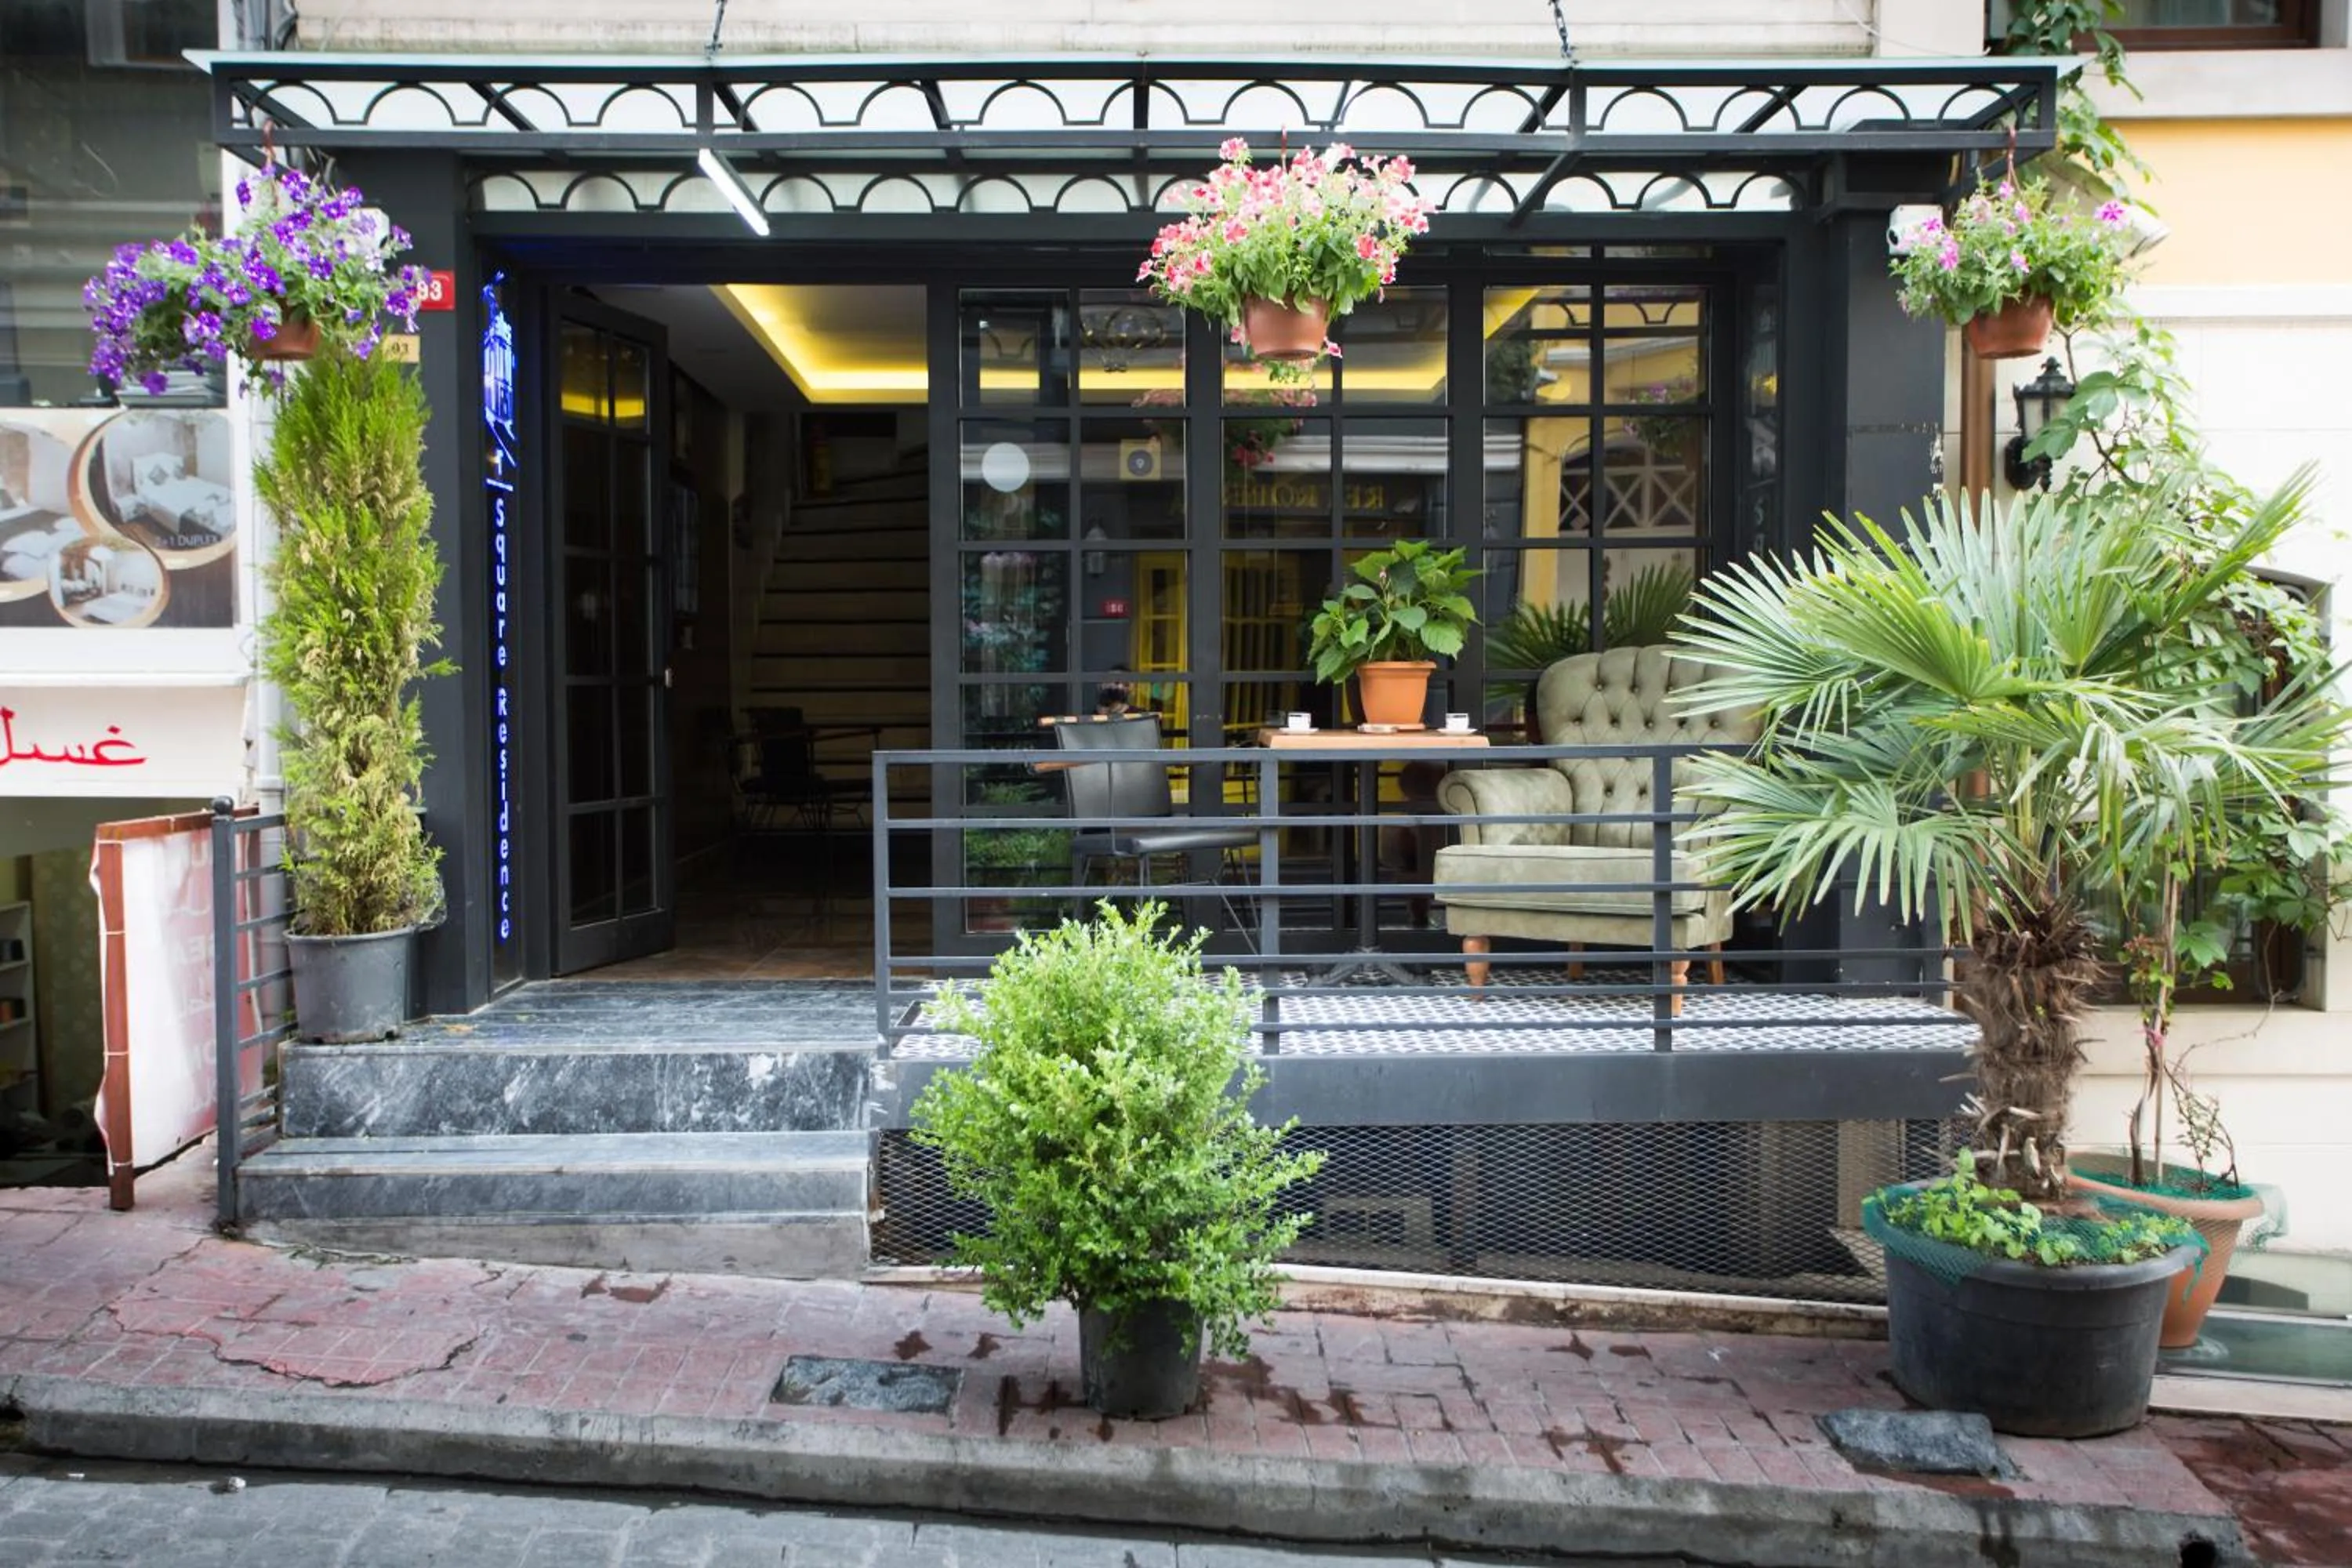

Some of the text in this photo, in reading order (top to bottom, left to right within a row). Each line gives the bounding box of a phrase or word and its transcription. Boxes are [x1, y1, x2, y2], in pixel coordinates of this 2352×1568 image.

[416, 280, 443, 301] 93
[495, 498, 510, 939] Square Residence
